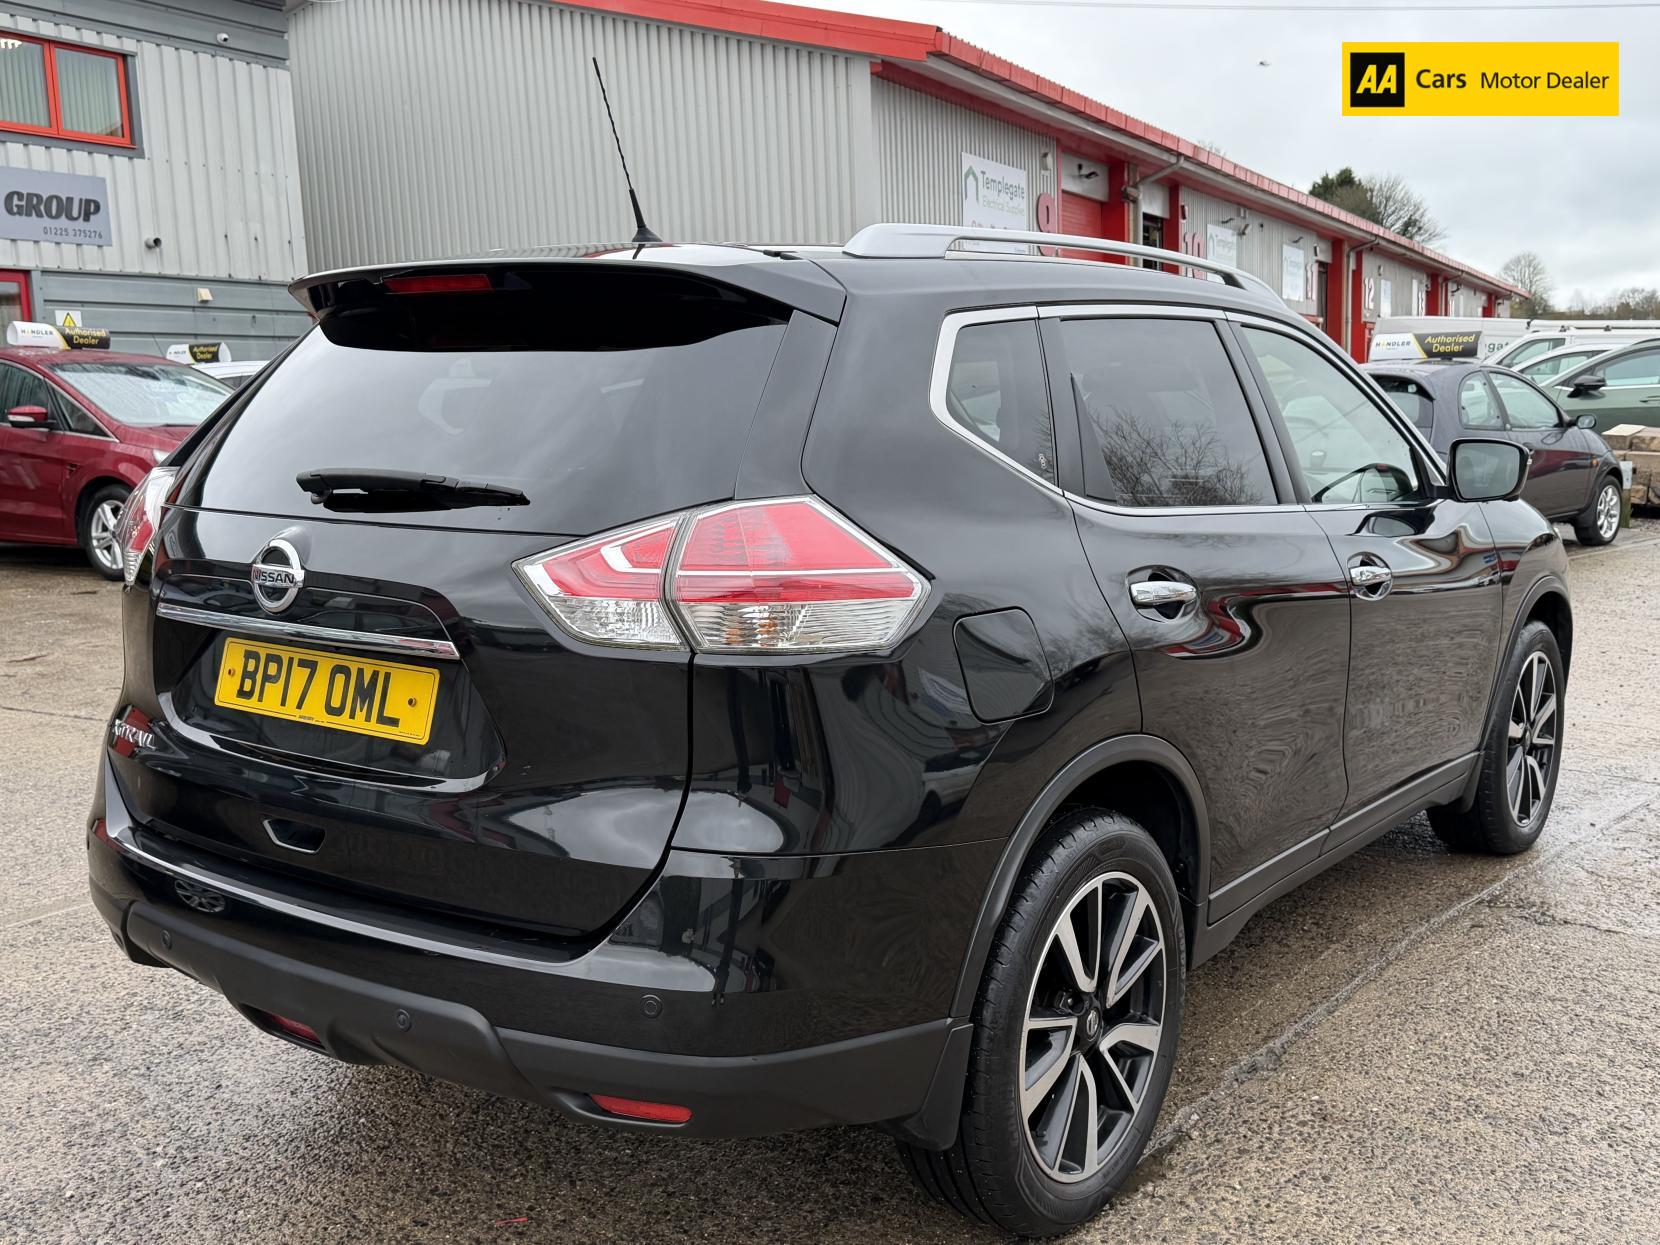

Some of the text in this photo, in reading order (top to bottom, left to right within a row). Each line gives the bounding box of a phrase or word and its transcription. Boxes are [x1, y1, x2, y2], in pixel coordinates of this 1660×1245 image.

[980, 170, 1025, 200] Templegate
[4, 190, 101, 222] GROUP
[43, 226, 103, 240] 01225 375276
[1364, 277, 1374, 310] 12
[64, 327, 107, 337] Authorised
[1424, 333, 1476, 344] Authorised
[73, 336, 99, 345] Dealer
[1432, 344, 1464, 353] Dealer
[252, 568, 294, 584] NISSAN
[236, 649, 401, 728] BP17 OML
